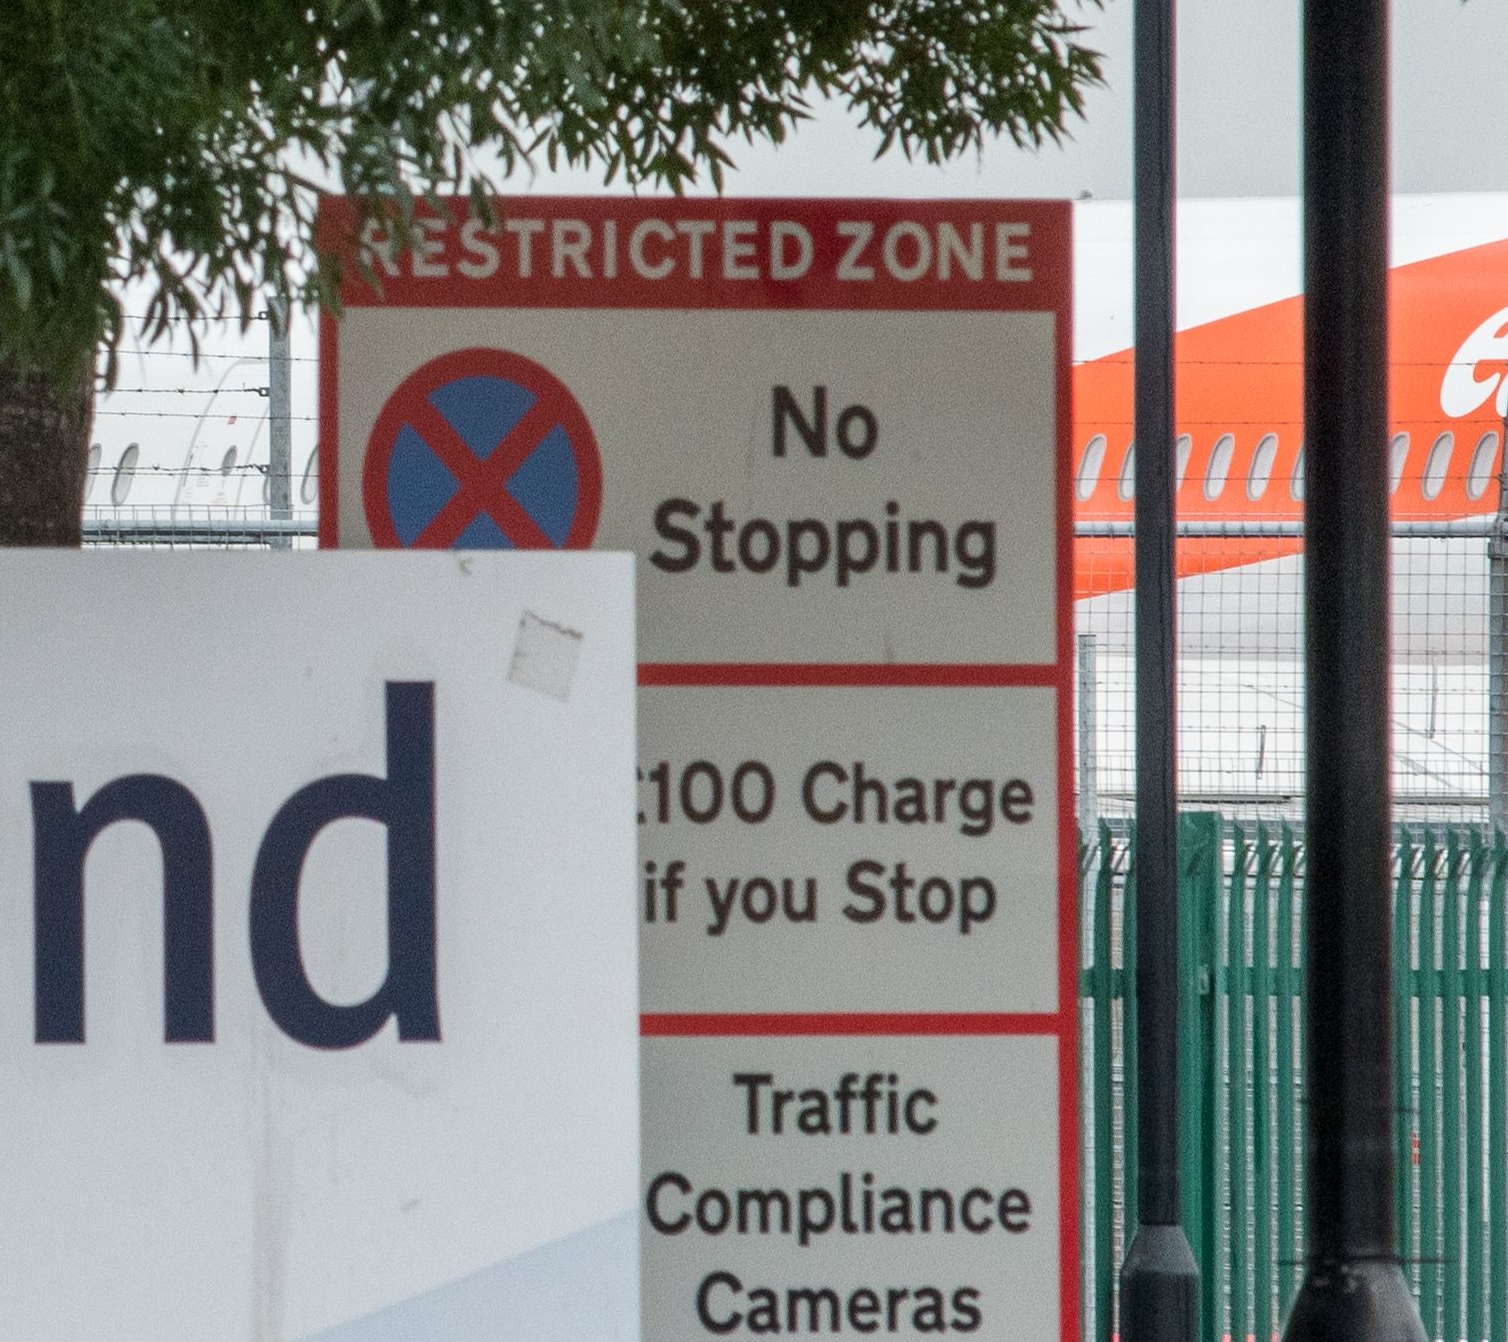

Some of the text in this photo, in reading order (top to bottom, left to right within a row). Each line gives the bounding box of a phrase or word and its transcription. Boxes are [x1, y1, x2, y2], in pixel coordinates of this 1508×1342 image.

[359, 217, 1034, 282] RESTRICTED ZONE
[772, 385, 879, 460] No
[649, 497, 996, 589] Stopping
[637, 759, 1034, 838] 100 Charge
[644, 859, 997, 937] if you Stop
[732, 1072, 938, 1136] Traffic
[645, 1170, 1032, 1247] Compliance
[695, 1270, 982, 1335] Cameras
